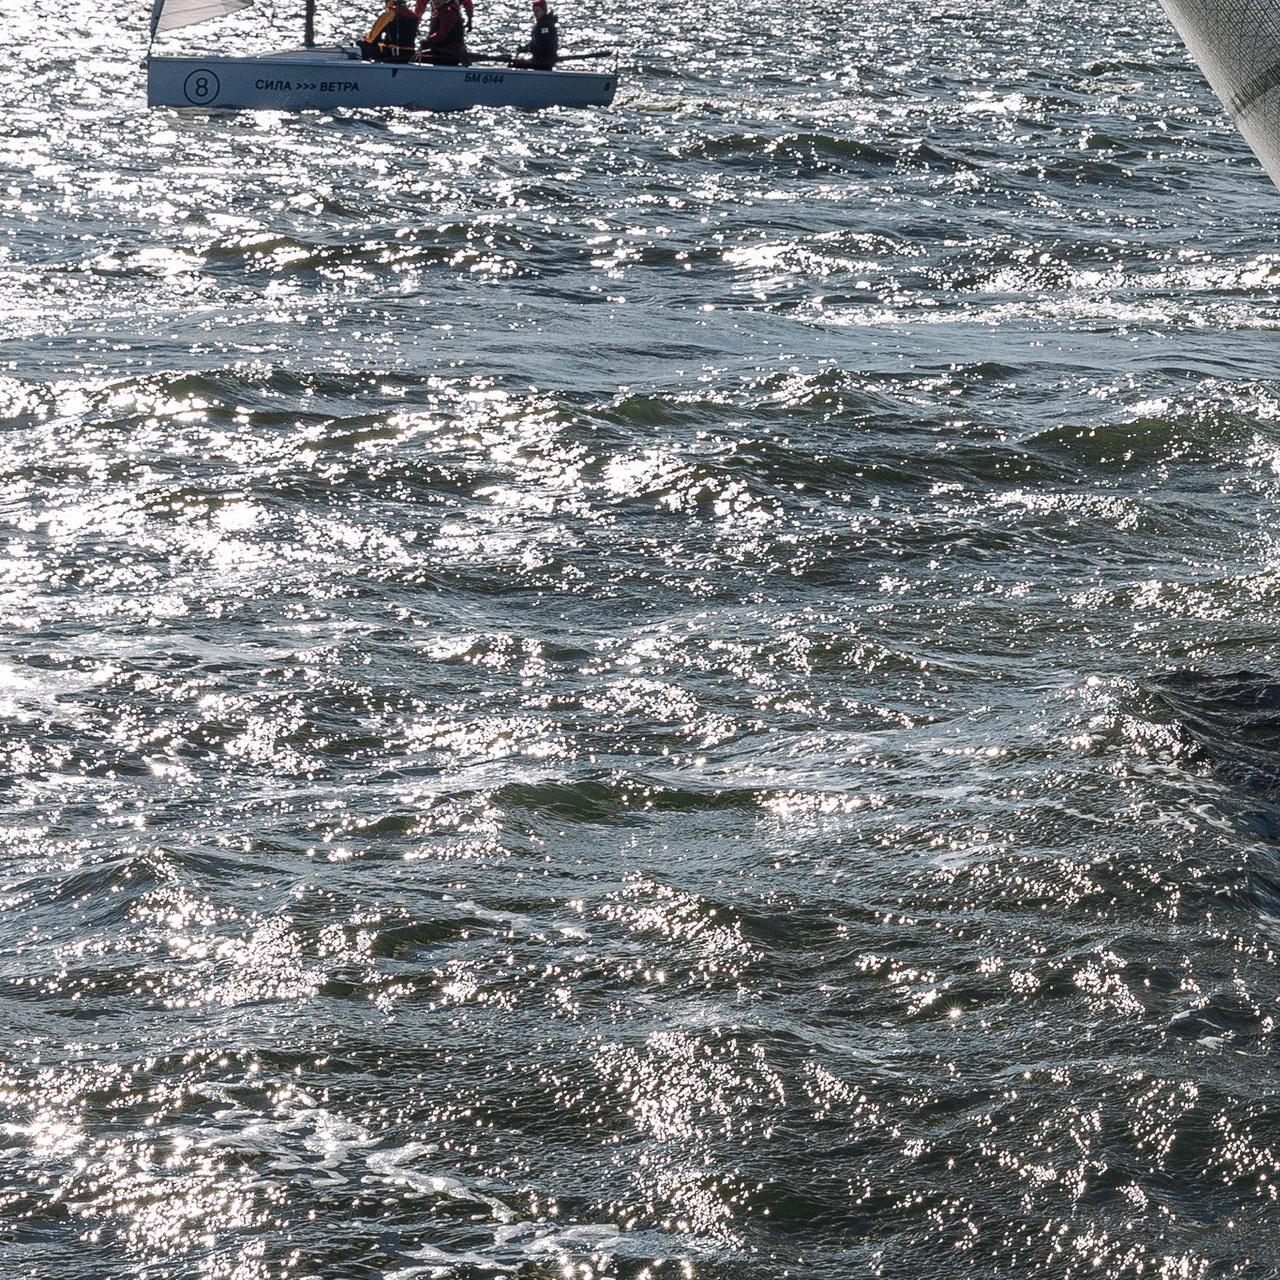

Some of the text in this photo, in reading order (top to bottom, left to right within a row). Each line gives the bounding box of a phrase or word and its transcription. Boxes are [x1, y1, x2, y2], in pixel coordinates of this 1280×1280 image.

[482, 74, 504, 84] 6144
[195, 77, 209, 98] 8
[255, 79, 360, 92] СИЛА ВЕТРА
[604, 82, 611, 92] 8
